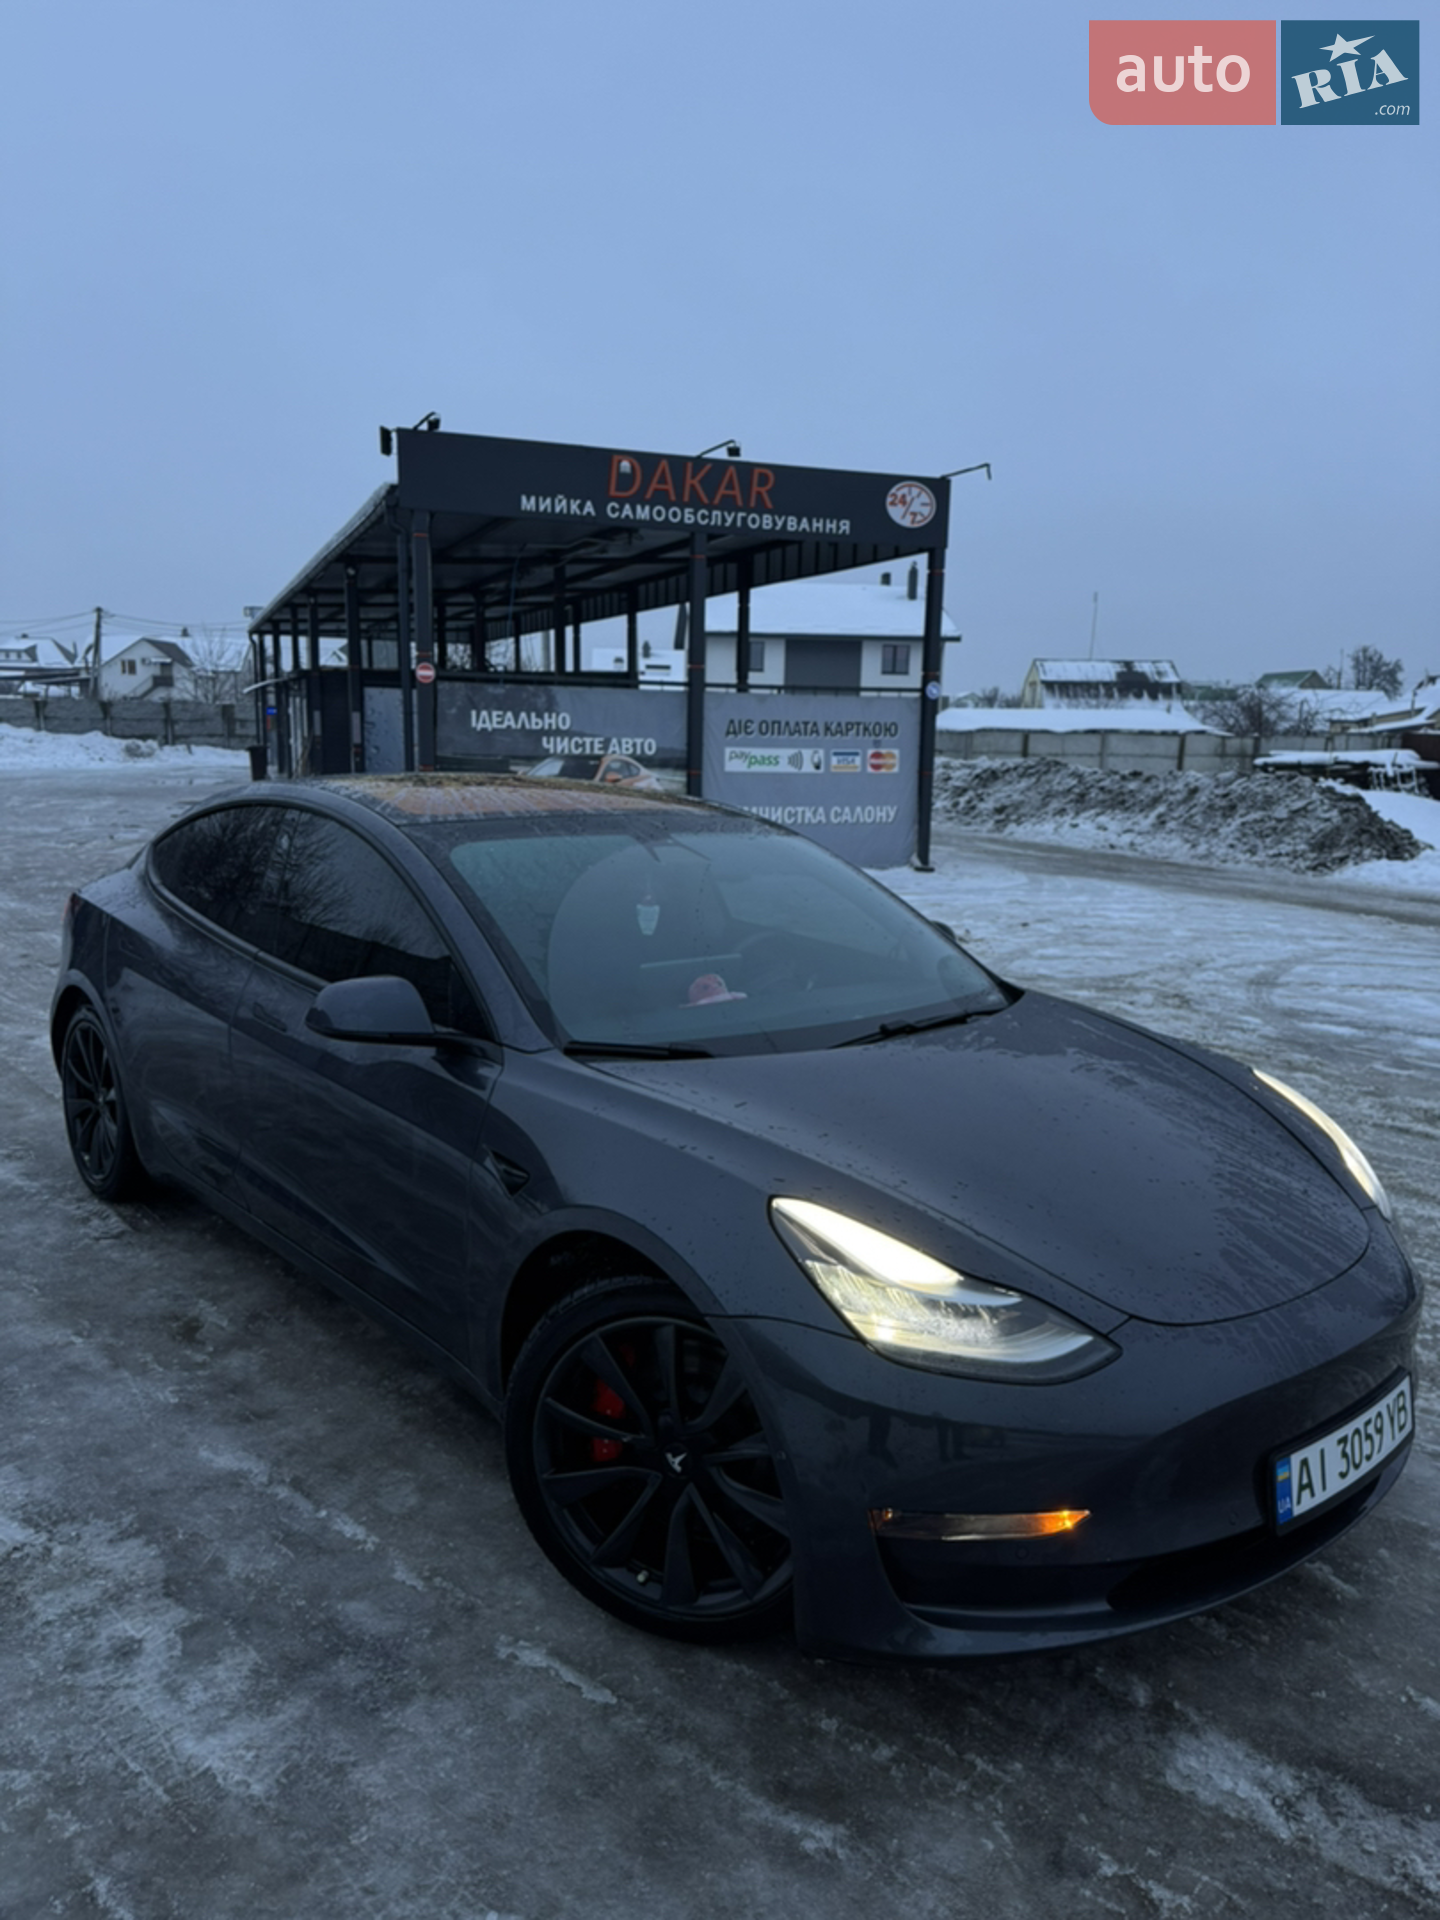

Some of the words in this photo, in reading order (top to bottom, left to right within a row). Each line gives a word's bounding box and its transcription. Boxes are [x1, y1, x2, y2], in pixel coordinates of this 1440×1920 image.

[607, 454, 776, 510] DAKAR
[520, 494, 596, 517] МИЙКА
[605, 502, 851, 535] САМООБСЛУГОВУВАННЯ
[470, 709, 572, 732] ІДЕАЛЬНО
[725, 718, 755, 738] ДІЄ
[758, 719, 820, 738] ОПЛАТА
[824, 720, 899, 738] КАРТКОЮ
[541, 735, 604, 755] ЧИСТЕ
[607, 737, 658, 756] АВТО
[830, 805, 898, 824] САЛОНУ
[1296, 1447, 1327, 1507] AI
[1336, 1410, 1385, 1480] 3059
[1386, 1389, 1409, 1442] YB
